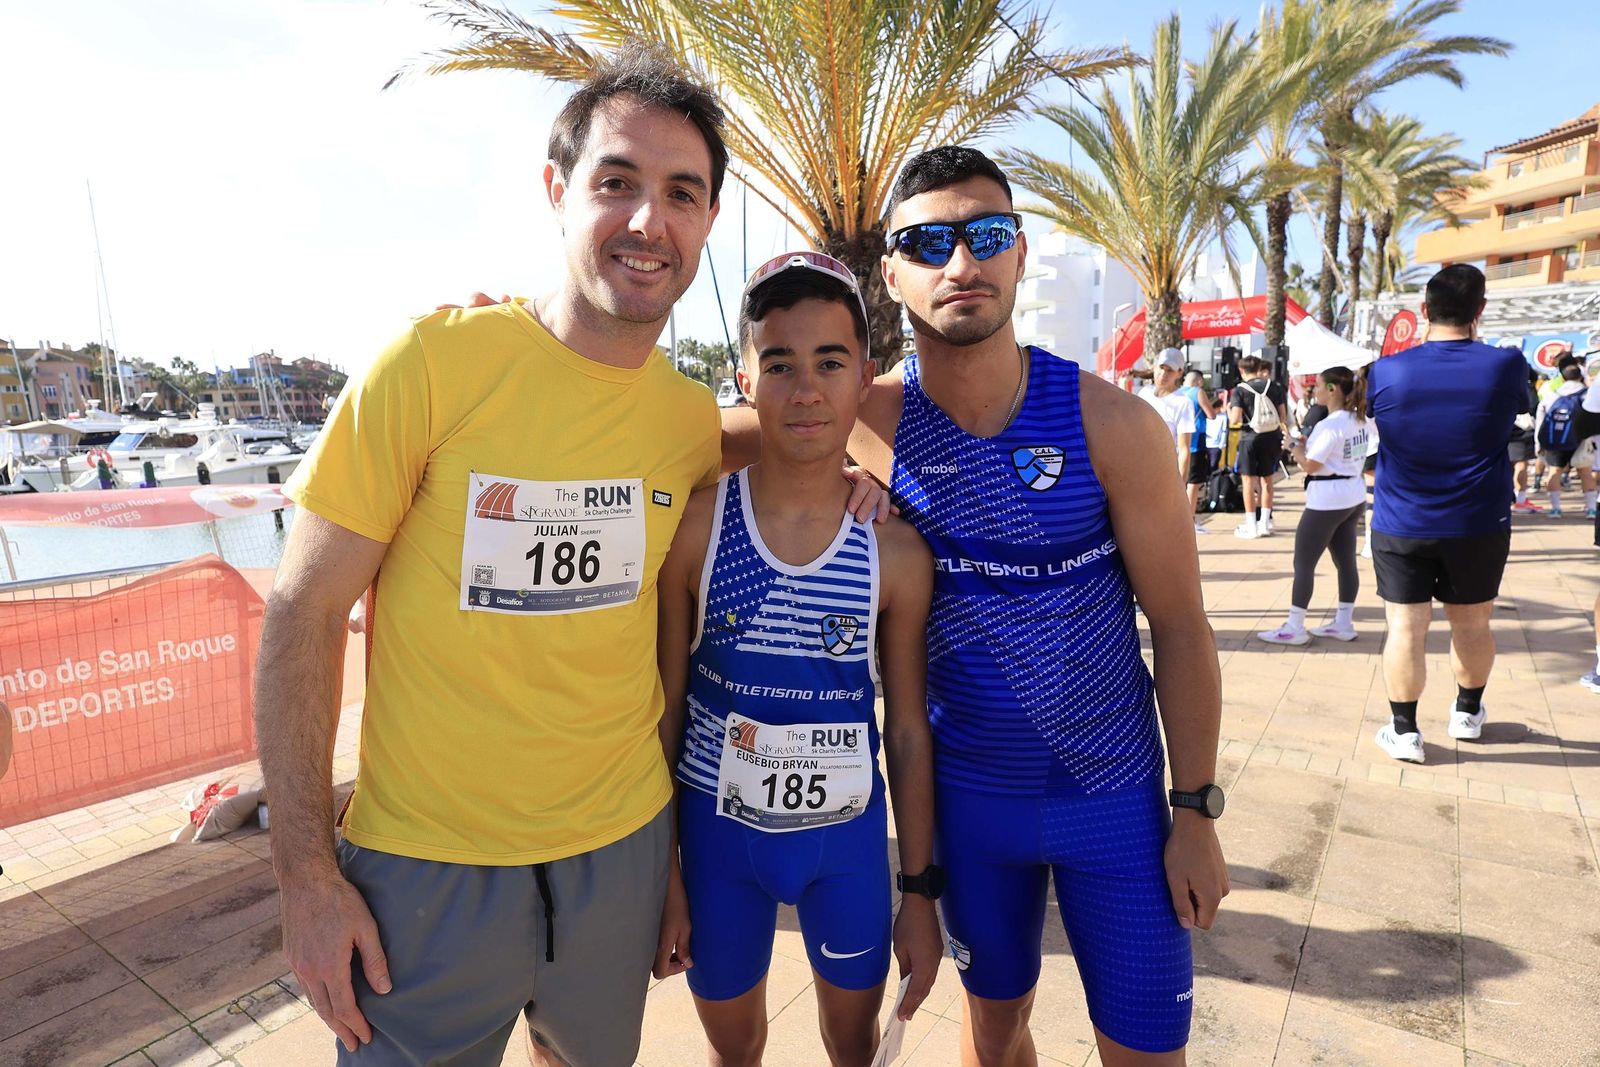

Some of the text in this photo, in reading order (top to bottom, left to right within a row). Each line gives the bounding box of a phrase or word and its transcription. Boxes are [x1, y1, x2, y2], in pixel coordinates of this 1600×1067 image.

[1210, 318, 1242, 328] ROQUE
[921, 463, 959, 474] mobel
[555, 486, 631, 508] The RUN
[84, 506, 101, 517] de
[101, 502, 126, 513] San
[610, 507, 632, 515] Challenge
[534, 525, 578, 536] JULIAN
[526, 540, 601, 585] 186
[1047, 537, 1118, 576] LINENS
[625, 568, 630, 576] L
[603, 589, 630, 599] BETANIA
[56, 658, 92, 684] de
[98, 649, 150, 675] San
[157, 634, 236, 664] Roque
[698, 663, 722, 685] CLUB
[725, 680, 813, 700] ATLETISMO
[14, 676, 175, 733] DEPORTES
[786, 730, 806, 742] The
[736, 749, 780, 770] EUSEBIO
[782, 760, 818, 770] BRYAN
[762, 773, 827, 810] 185
